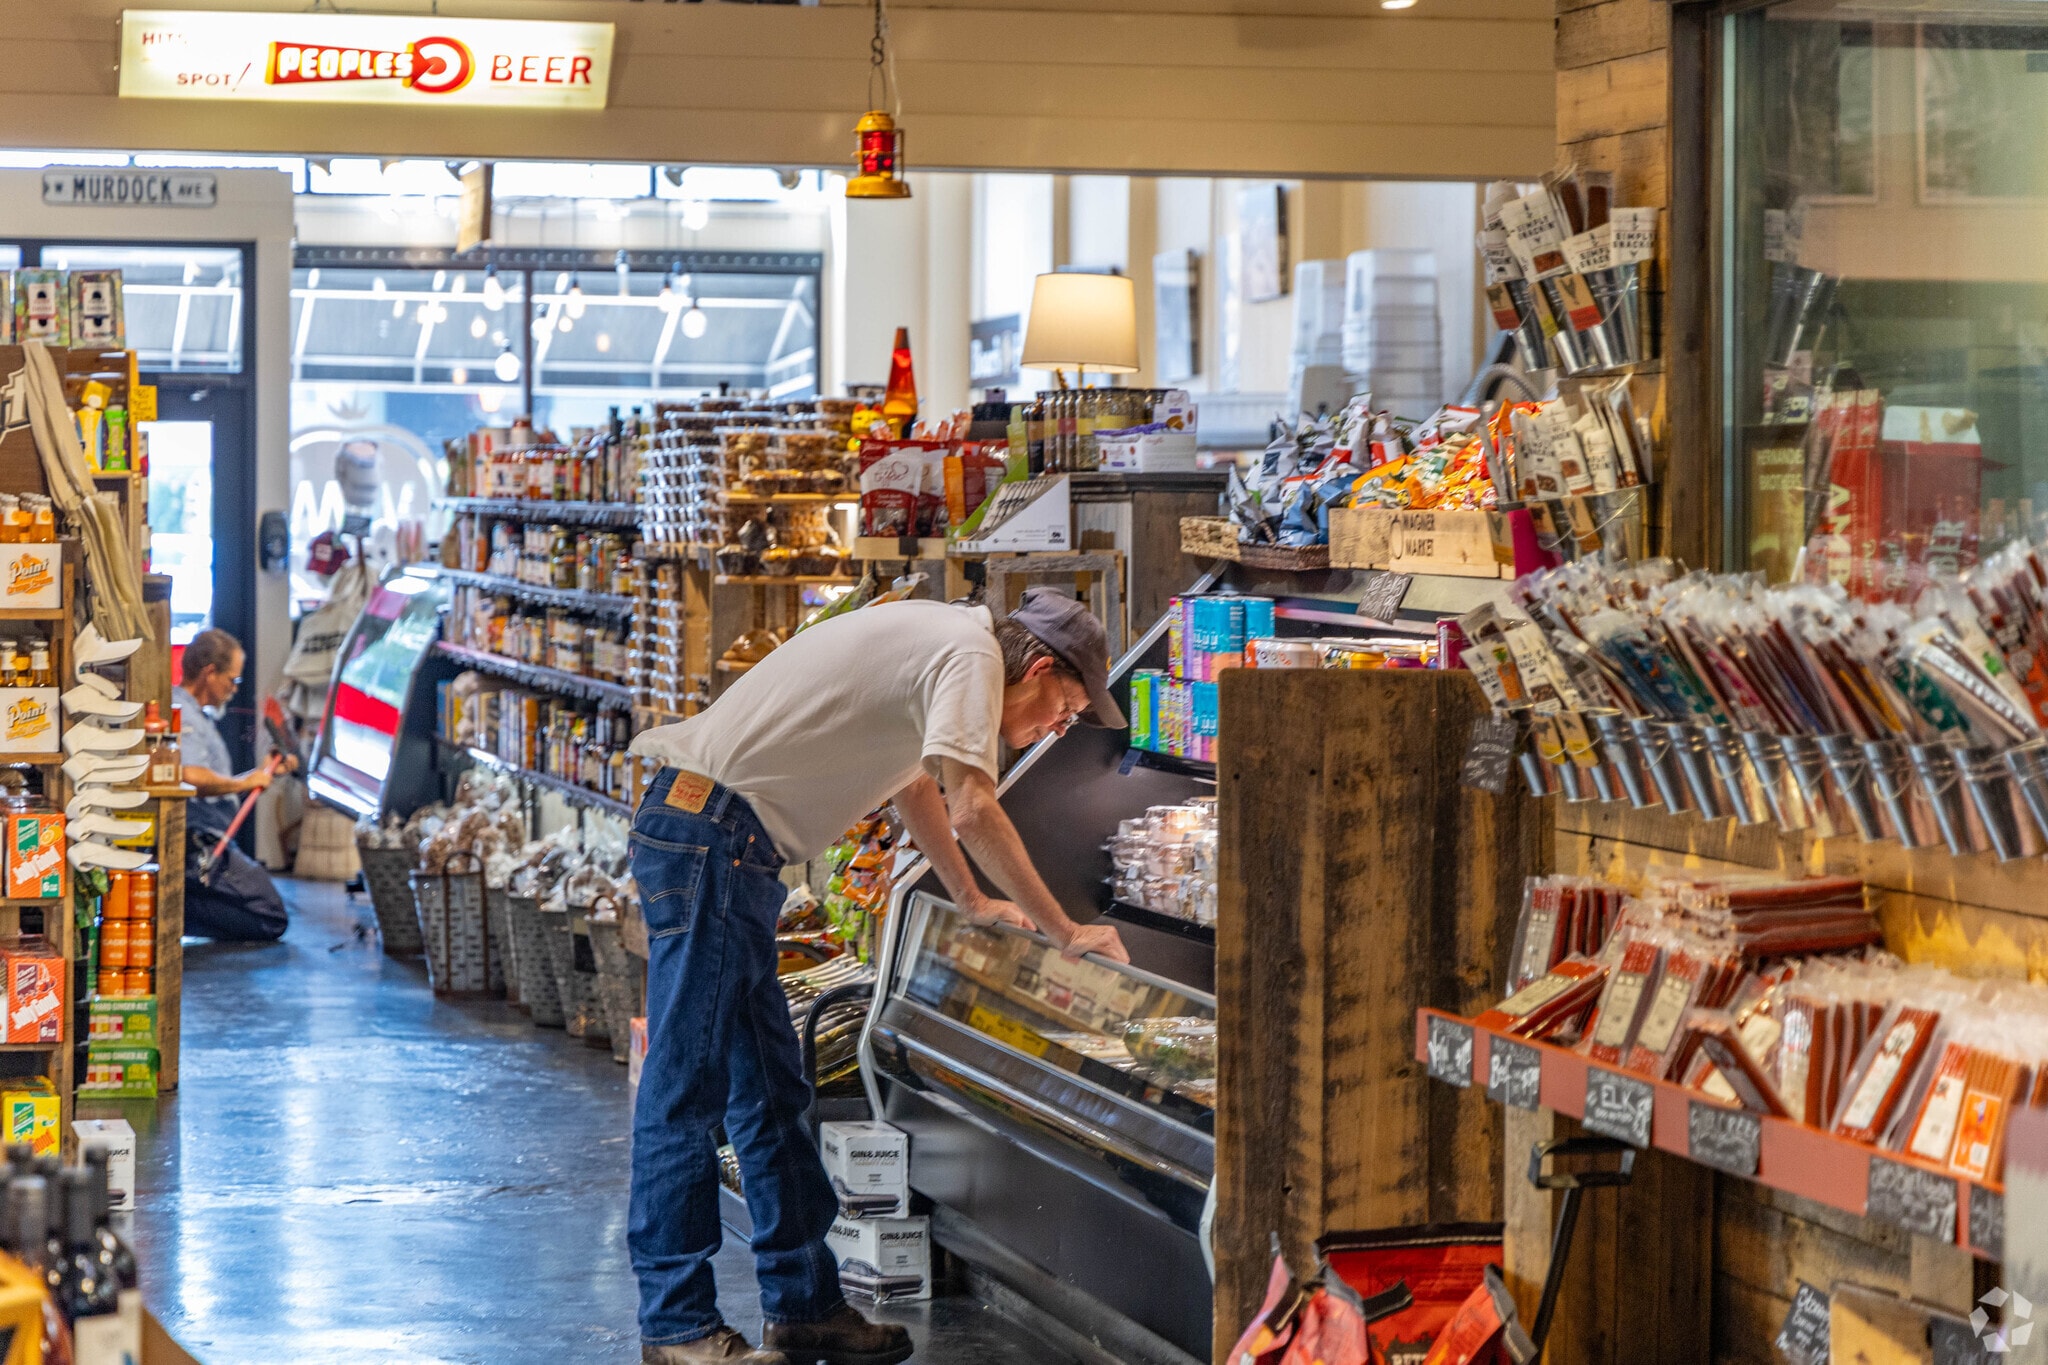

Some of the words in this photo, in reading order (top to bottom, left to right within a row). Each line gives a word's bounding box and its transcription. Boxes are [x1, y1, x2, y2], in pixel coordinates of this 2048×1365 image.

[276, 46, 414, 80] PEOPLES
[490, 54, 592, 84] BEER
[73, 174, 172, 204] MURDOCK
[1403, 513, 1435, 531] WAGNER
[1828, 482, 1852, 587] AMB
[1405, 538, 1434, 557] MARKET
[9, 557, 50, 585] Point
[7, 702, 48, 730] Point
[874, 1150, 900, 1159] JUICE
[901, 1230, 924, 1240] JUICE
